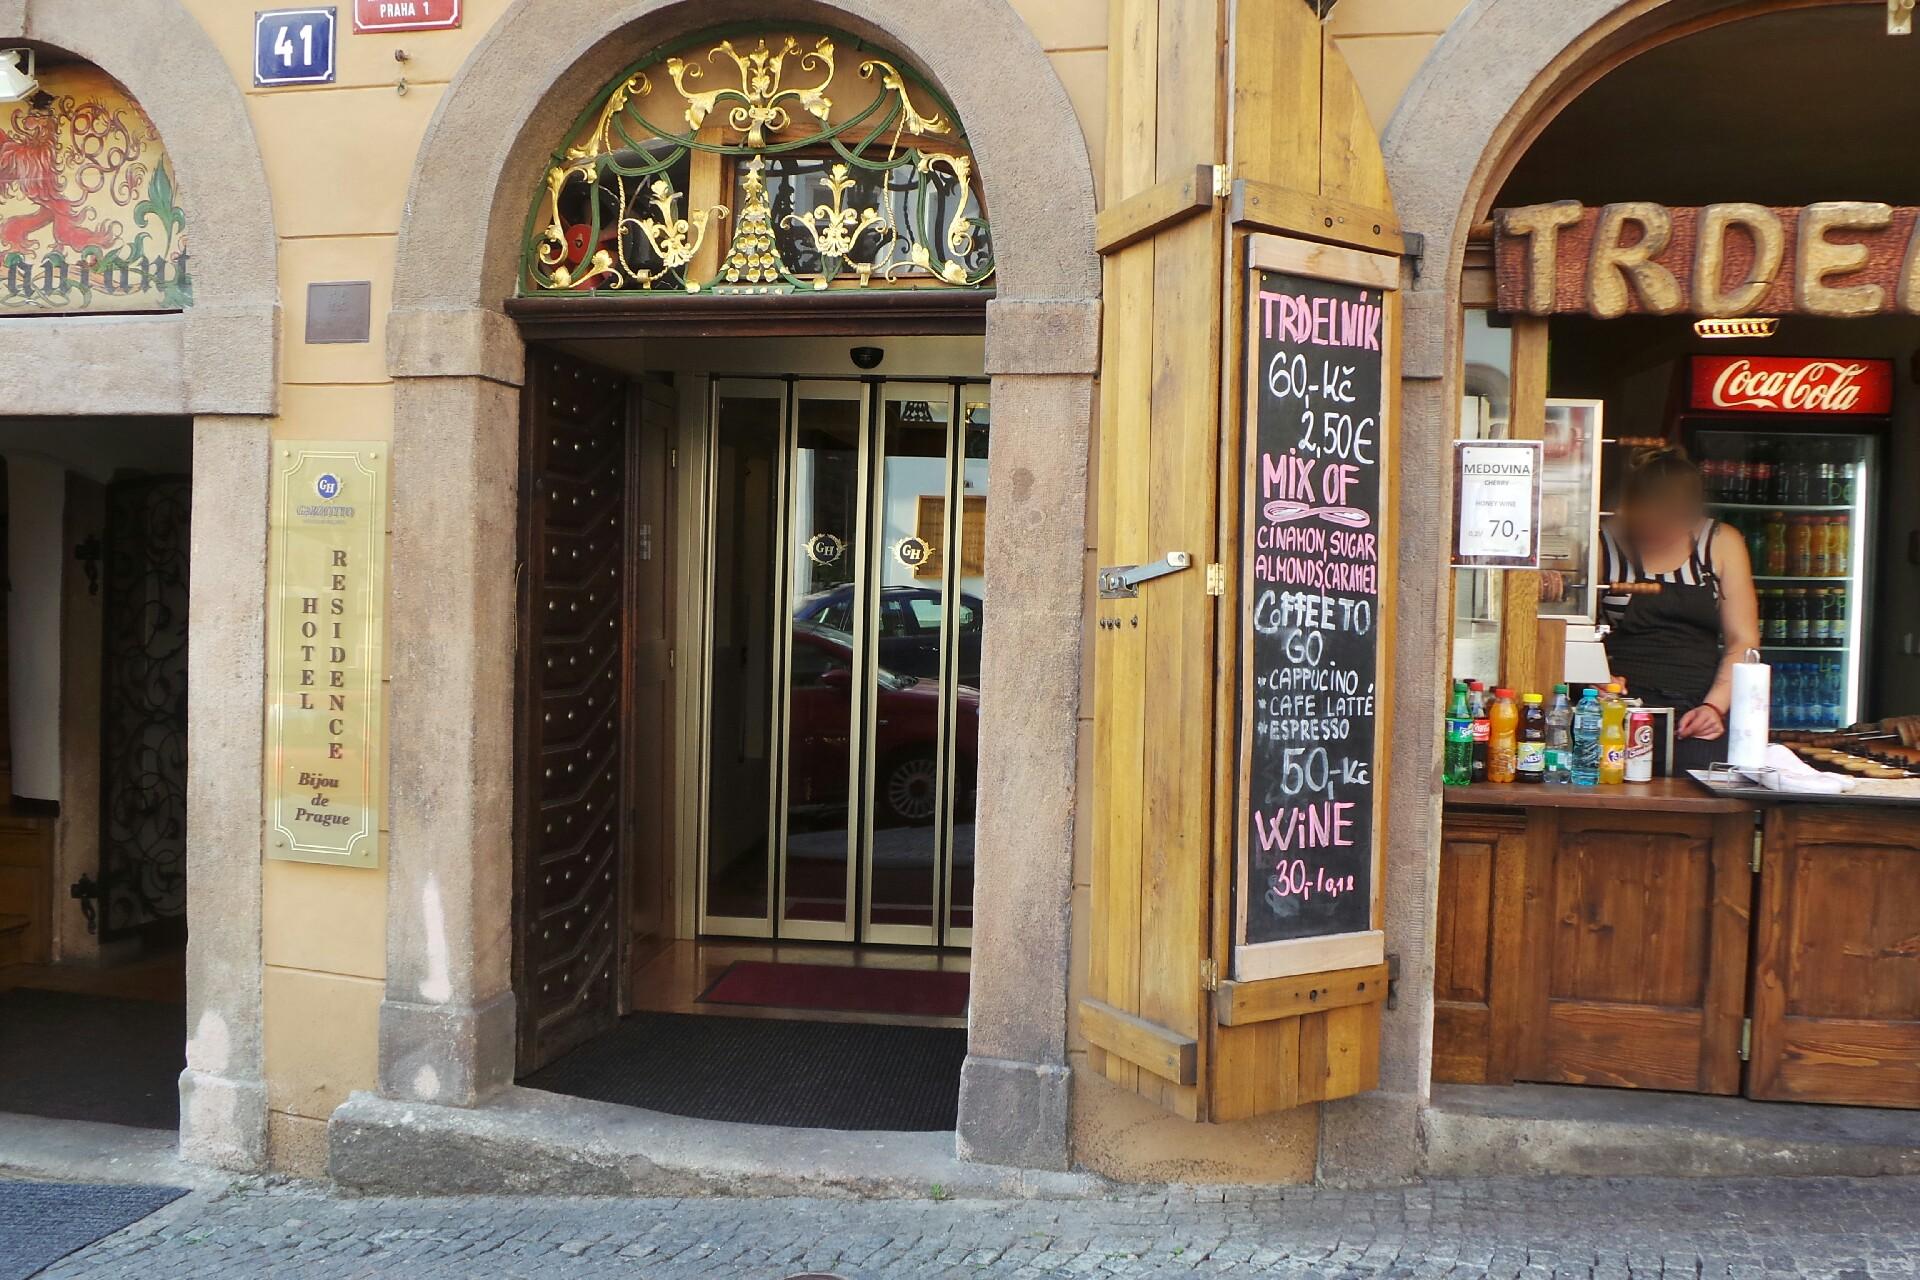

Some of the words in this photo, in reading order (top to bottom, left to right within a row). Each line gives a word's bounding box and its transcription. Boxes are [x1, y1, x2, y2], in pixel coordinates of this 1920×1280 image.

[380, 2, 416, 18] PRAHA
[422, 1, 429, 16] 1
[274, 24, 313, 67] 41
[1500, 198, 1920, 320] TRDE
[1712, 359, 1869, 411] Coca-Cola
[1298, 410, 1375, 464] 2,50€
[1322, 463, 1360, 506] OF
[1464, 463, 1531, 475] MEDOVINA
[319, 479, 336, 494] GH
[1329, 530, 1377, 562] SUGAR
[1488, 519, 1529, 541] 70,-
[815, 541, 835, 557] GH
[902, 544, 922, 560] GH
[1324, 562, 1377, 595] CARAMEL
[1338, 597, 1371, 636] TO
[300, 597, 319, 710] HOTEL
[328, 550, 349, 760] RESIDENCE
[1286, 628, 1323, 667] GO
[1270, 695, 1316, 716] CAFE
[298, 772, 340, 790] Bijou
[311, 793, 329, 807] de
[295, 808, 351, 827] Prague
